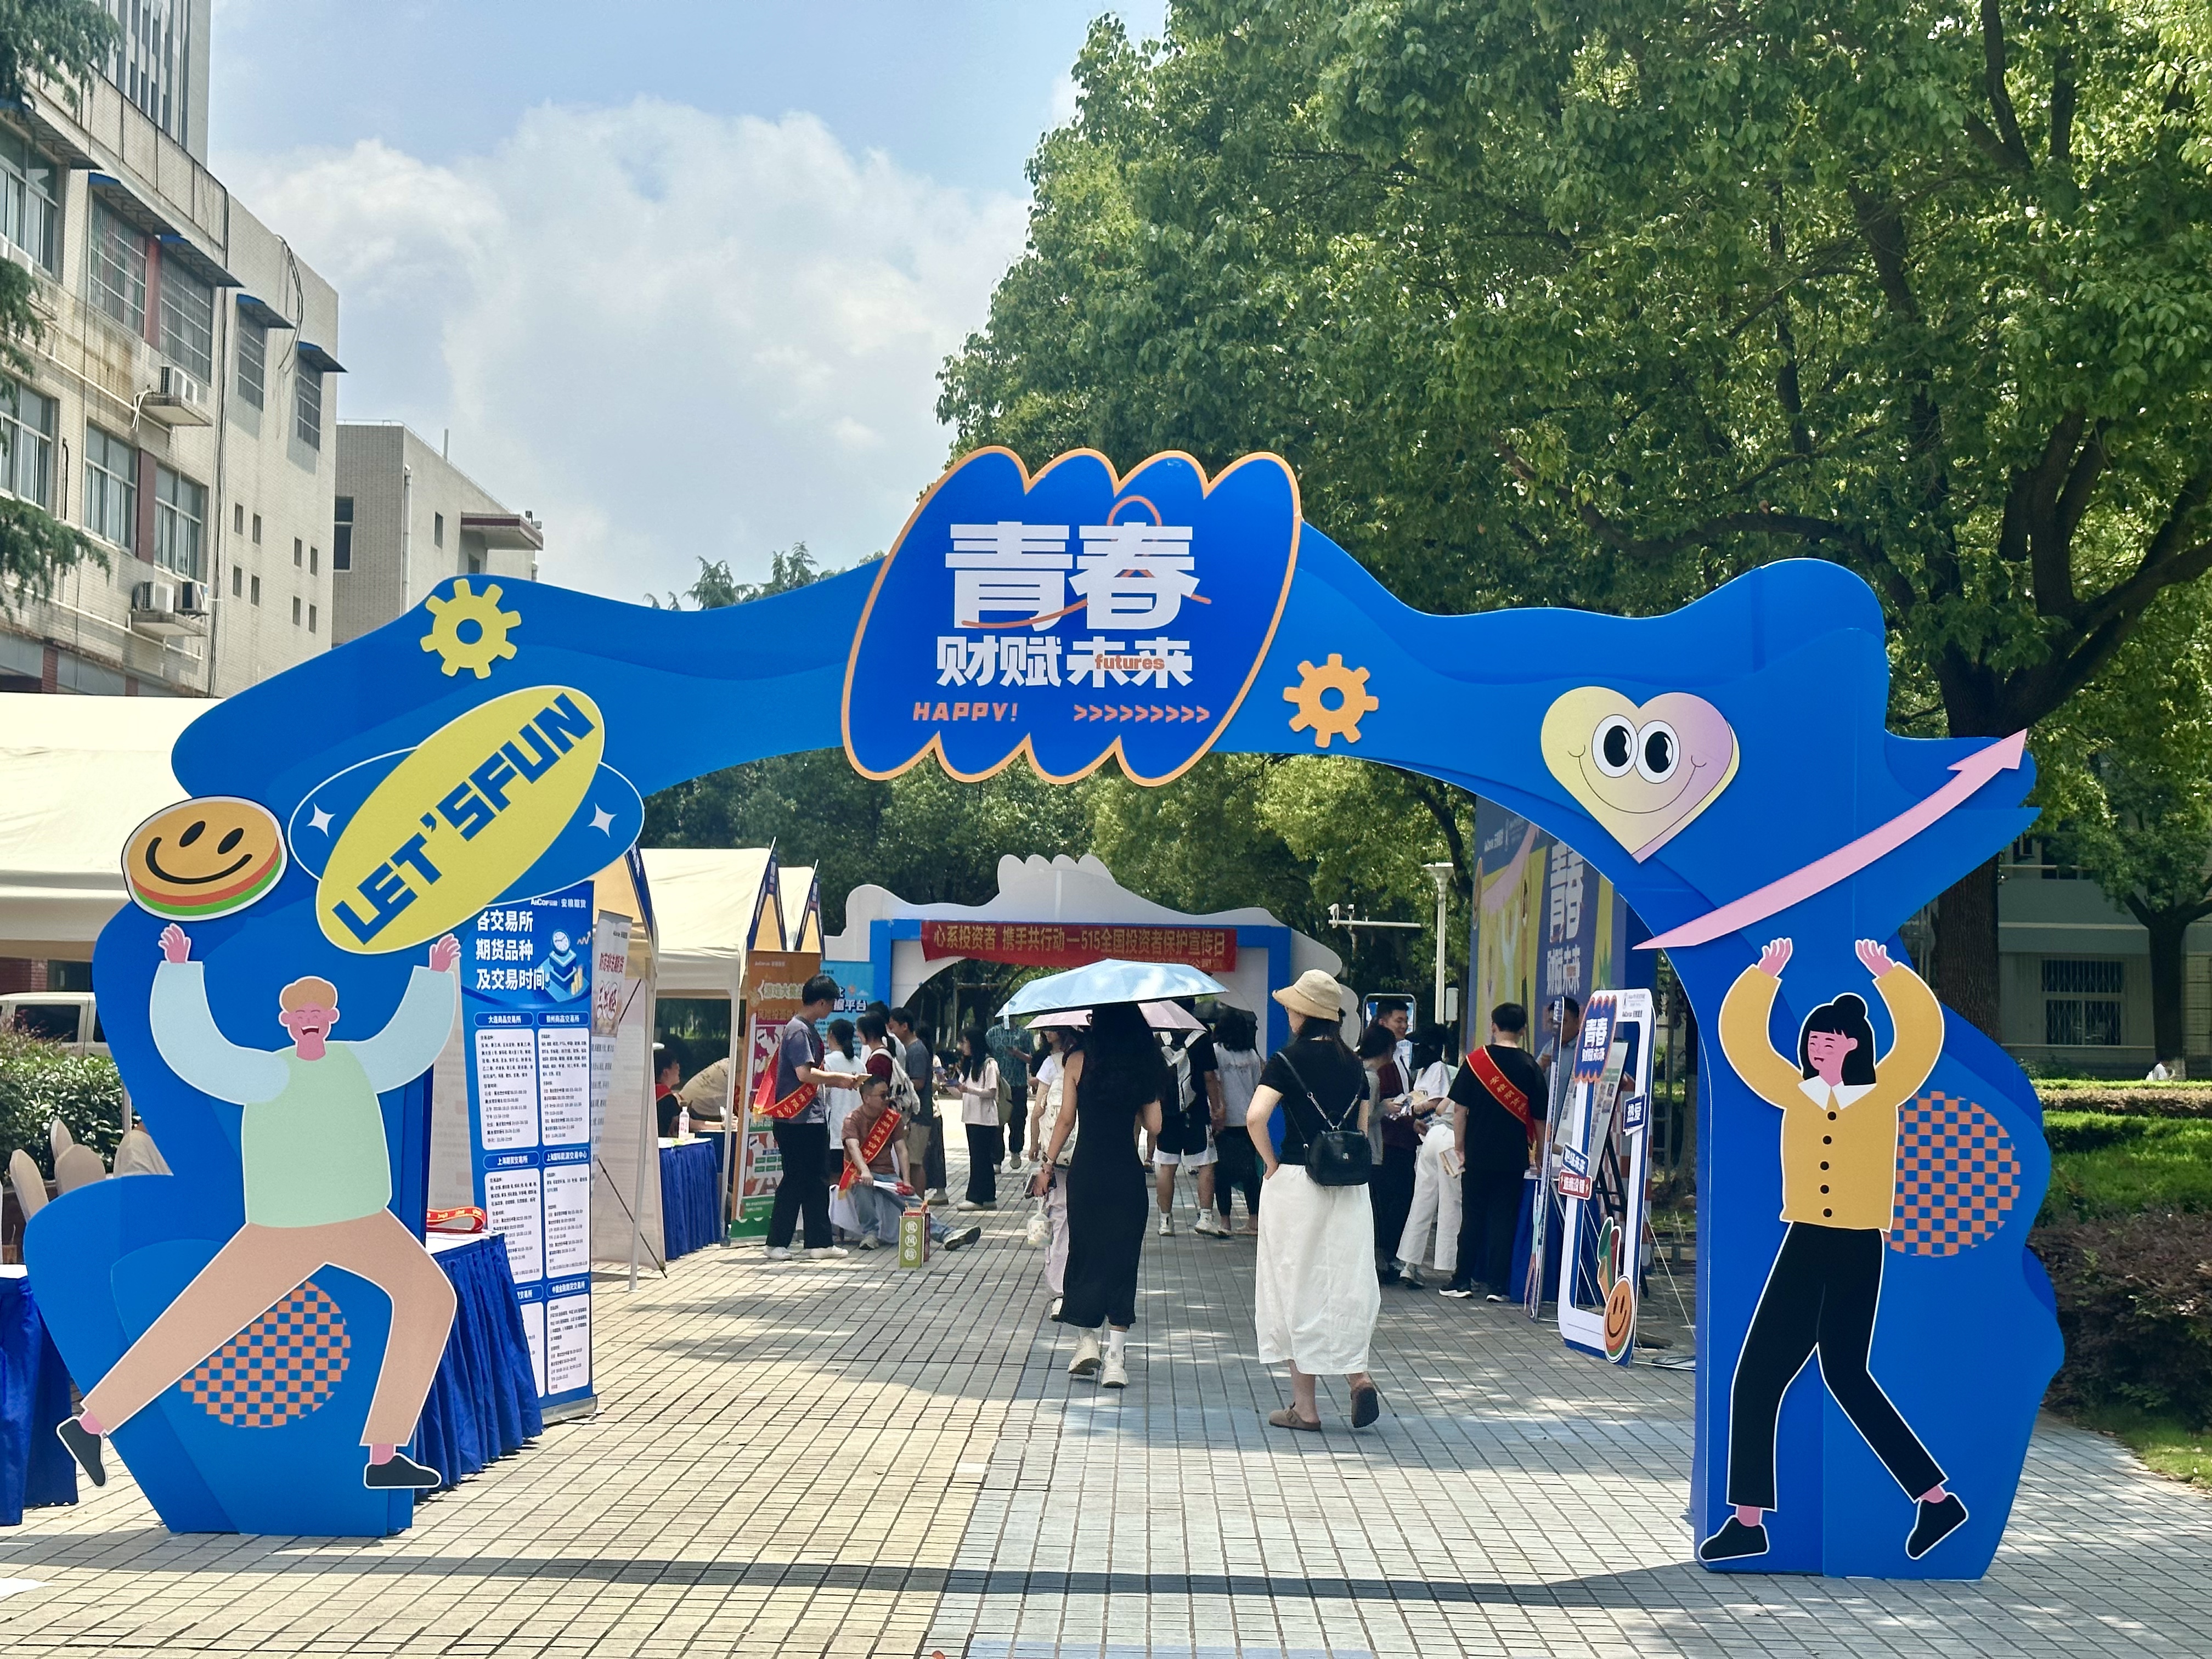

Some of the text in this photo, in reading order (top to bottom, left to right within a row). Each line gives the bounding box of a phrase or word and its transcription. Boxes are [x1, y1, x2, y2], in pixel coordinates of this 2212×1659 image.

[945, 521, 1200, 631] 青春
[936, 635, 1193, 689] 财赋未来
[1095, 653, 1165, 670] futures
[913, 702, 1019, 721] HAPPY!
[934, 924, 996, 951] 心系投资者
[476, 938, 533, 961] 期货品种
[476, 968, 545, 991] 及交易时间
